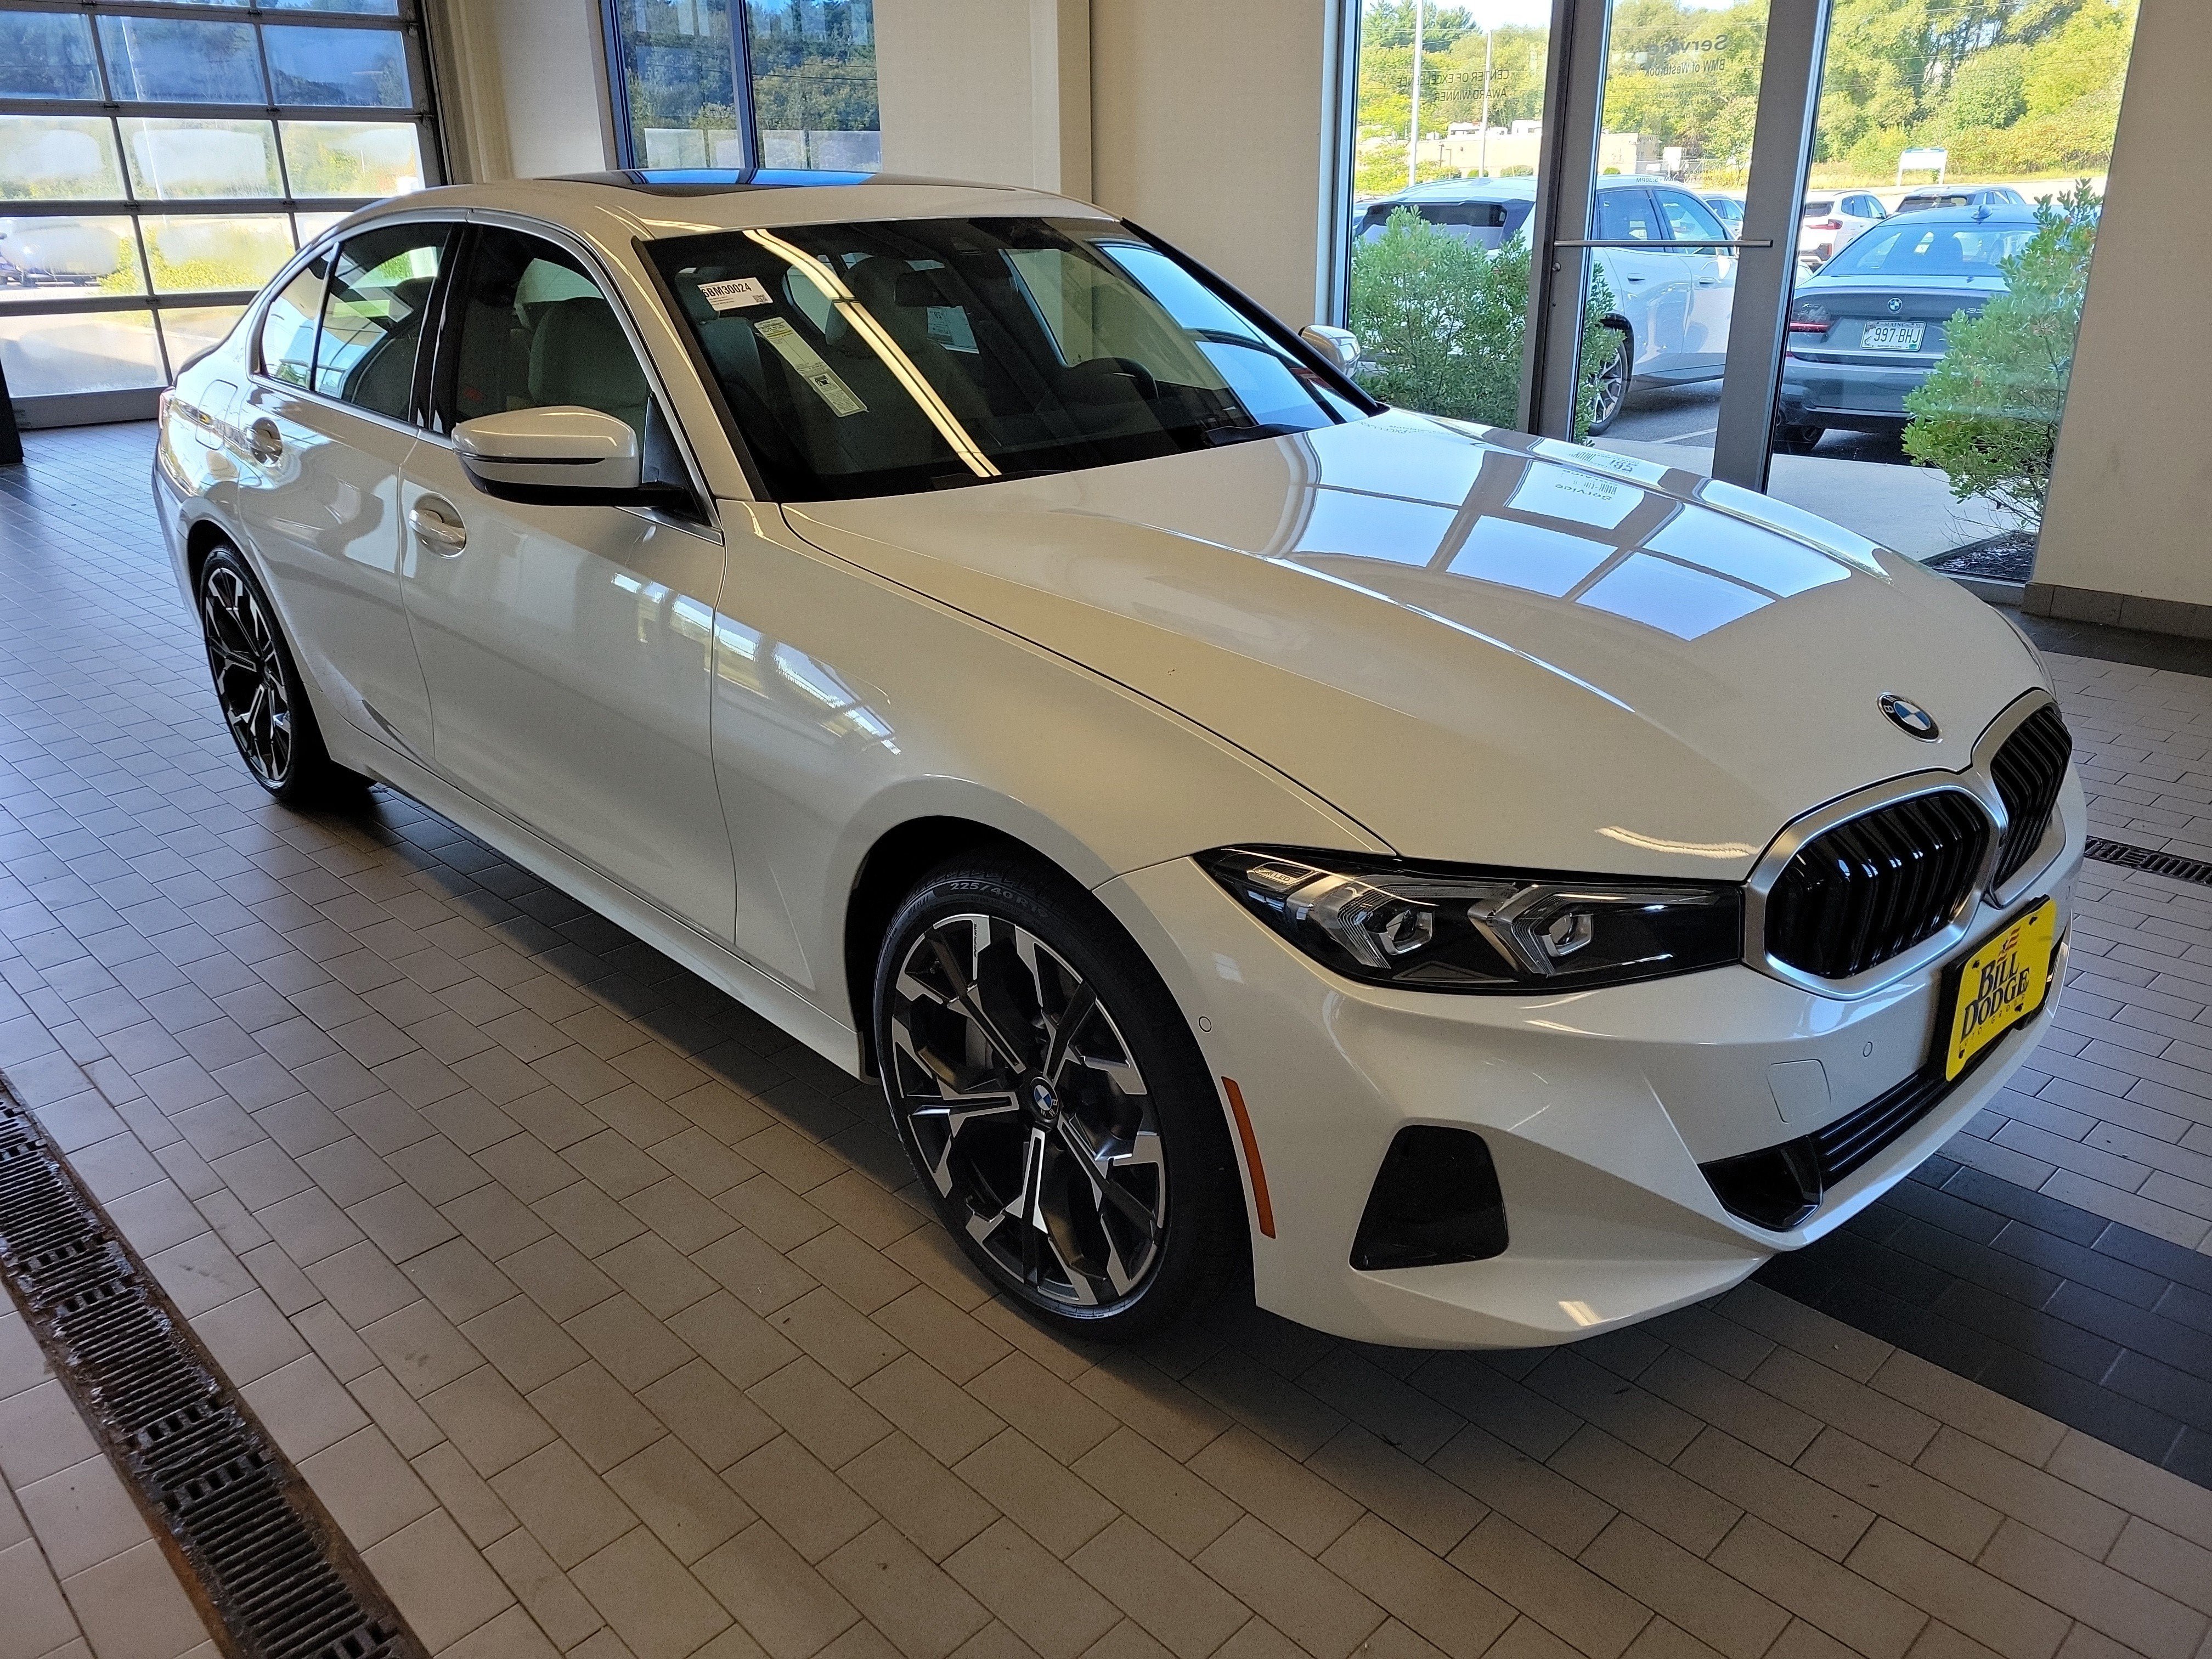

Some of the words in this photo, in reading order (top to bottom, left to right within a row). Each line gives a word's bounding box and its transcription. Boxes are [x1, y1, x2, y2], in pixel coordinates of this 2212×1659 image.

[701, 283, 752, 297] 6BM30024
[1274, 873, 1290, 882] LED
[950, 882, 1013, 899] 225/40
[1977, 951, 2020, 1003] BILL
[1959, 967, 2030, 1045] DODGE
